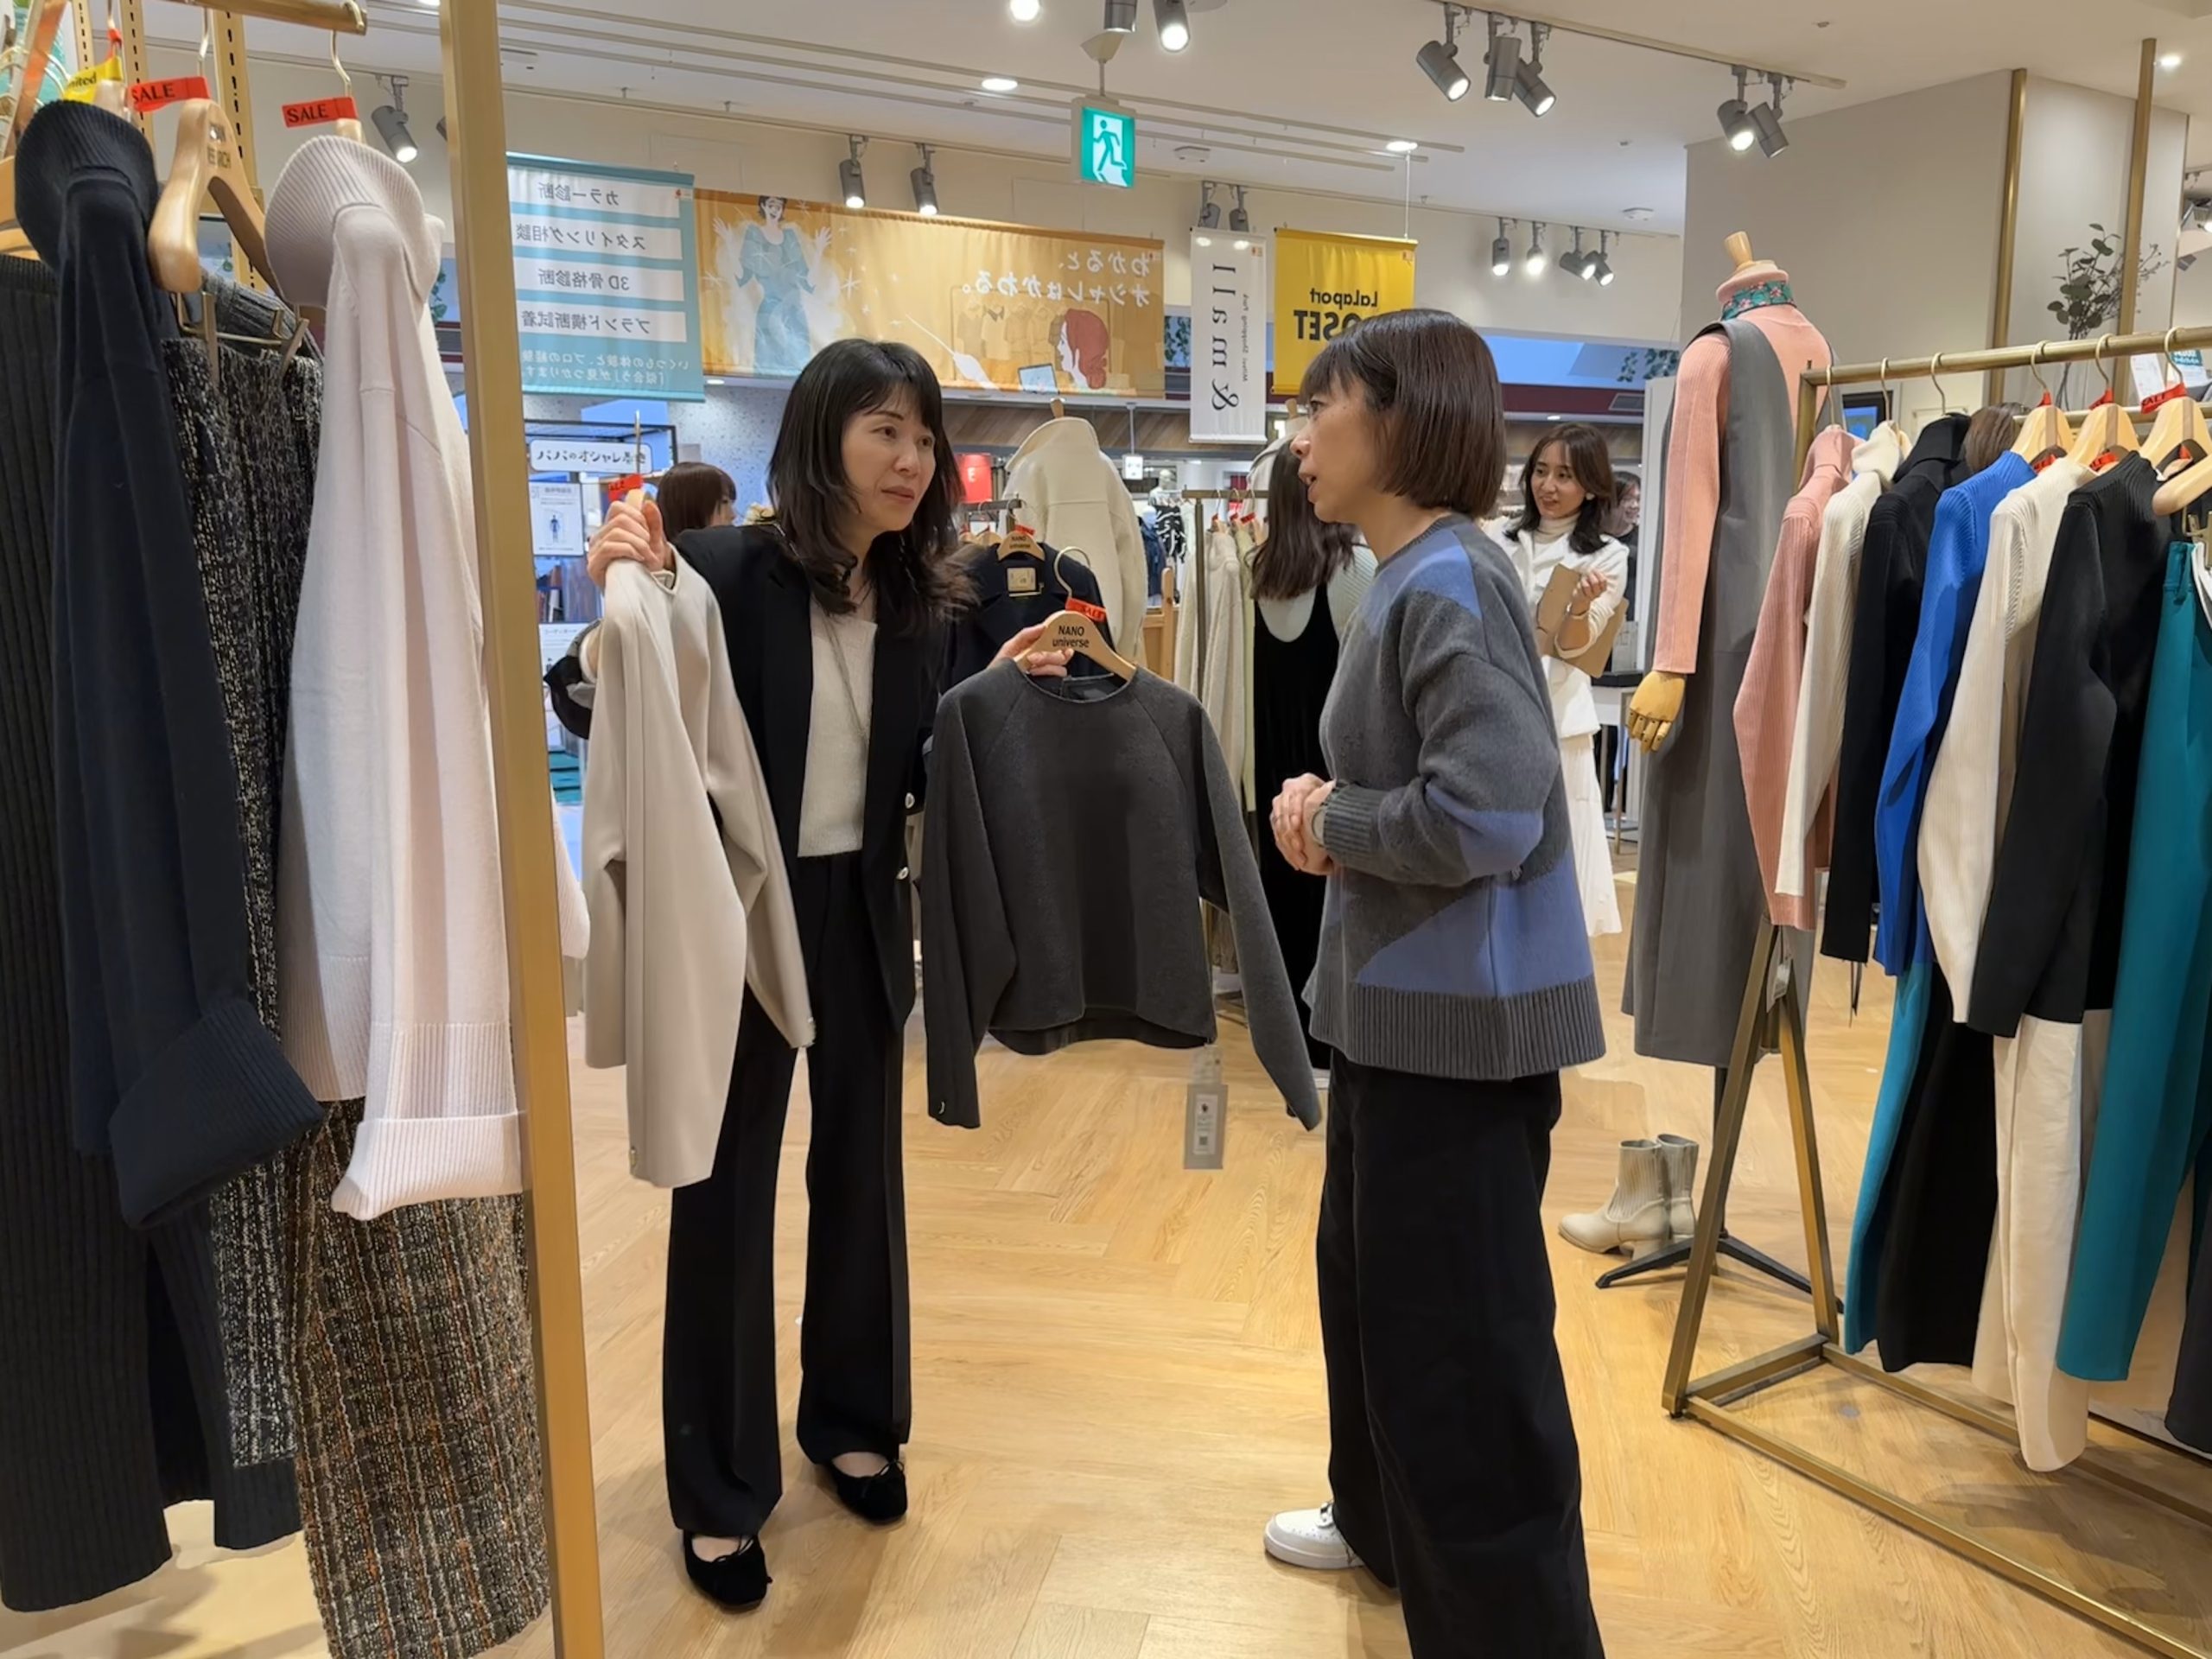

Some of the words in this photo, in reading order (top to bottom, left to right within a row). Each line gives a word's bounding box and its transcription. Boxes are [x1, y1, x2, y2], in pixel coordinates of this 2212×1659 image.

[131, 83, 175, 104] SALE
[287, 104, 328, 124] SALE
[1058, 625, 1085, 637] NANO
[1052, 637, 1090, 648] universe
